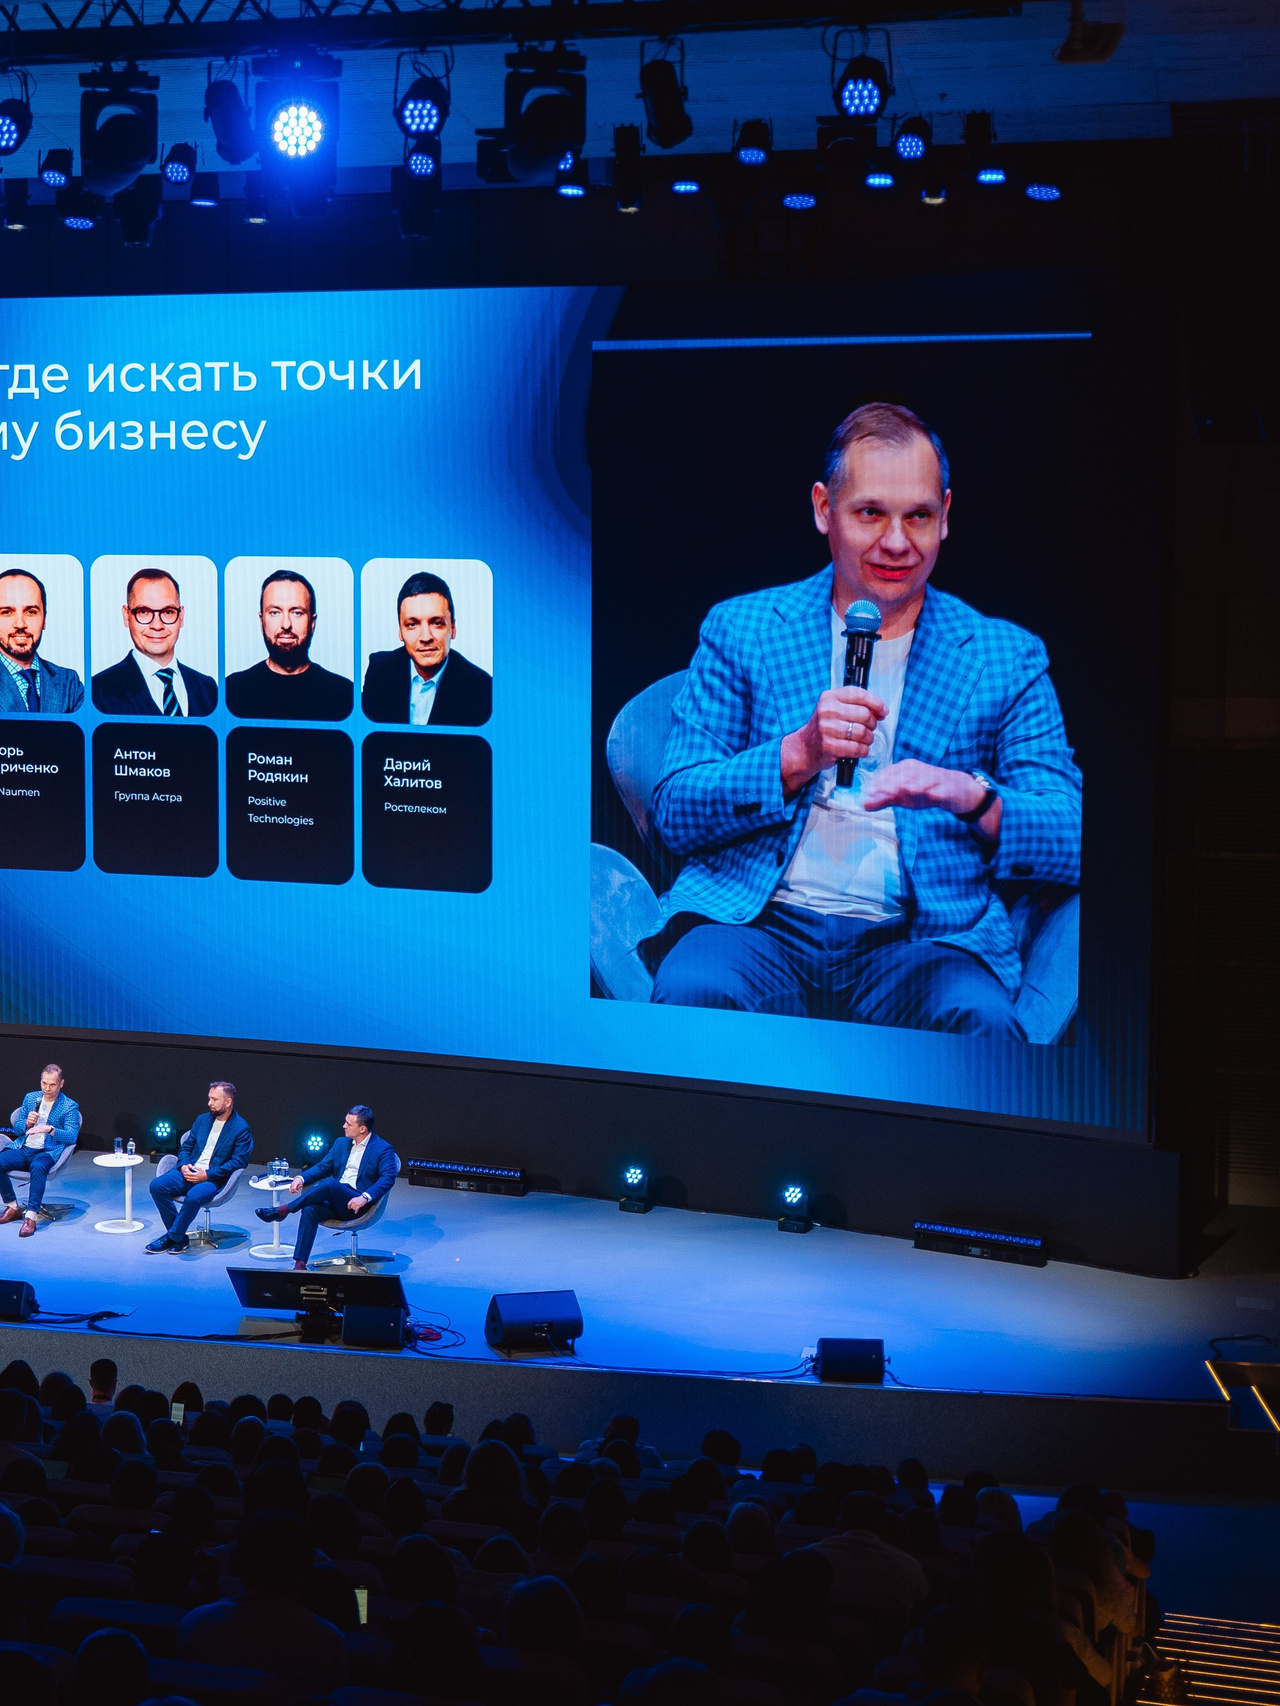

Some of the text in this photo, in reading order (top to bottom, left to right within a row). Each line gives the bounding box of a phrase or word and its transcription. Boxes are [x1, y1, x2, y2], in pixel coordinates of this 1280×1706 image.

[88, 362, 258, 393] искать
[272, 361, 422, 392] точки
[55, 410, 267, 461] бизнесу
[114, 748, 155, 760] Антон
[248, 753, 292, 765] Роман
[115, 765, 170, 777] Шмаков
[384, 758, 430, 772] Дарий
[248, 770, 308, 783] Родякин
[384, 775, 442, 789] Халитов
[115, 791, 182, 803] Группа Астра
[248, 796, 286, 806] Positive
[385, 802, 446, 814] Ростелеком
[248, 814, 314, 826] Technologies
